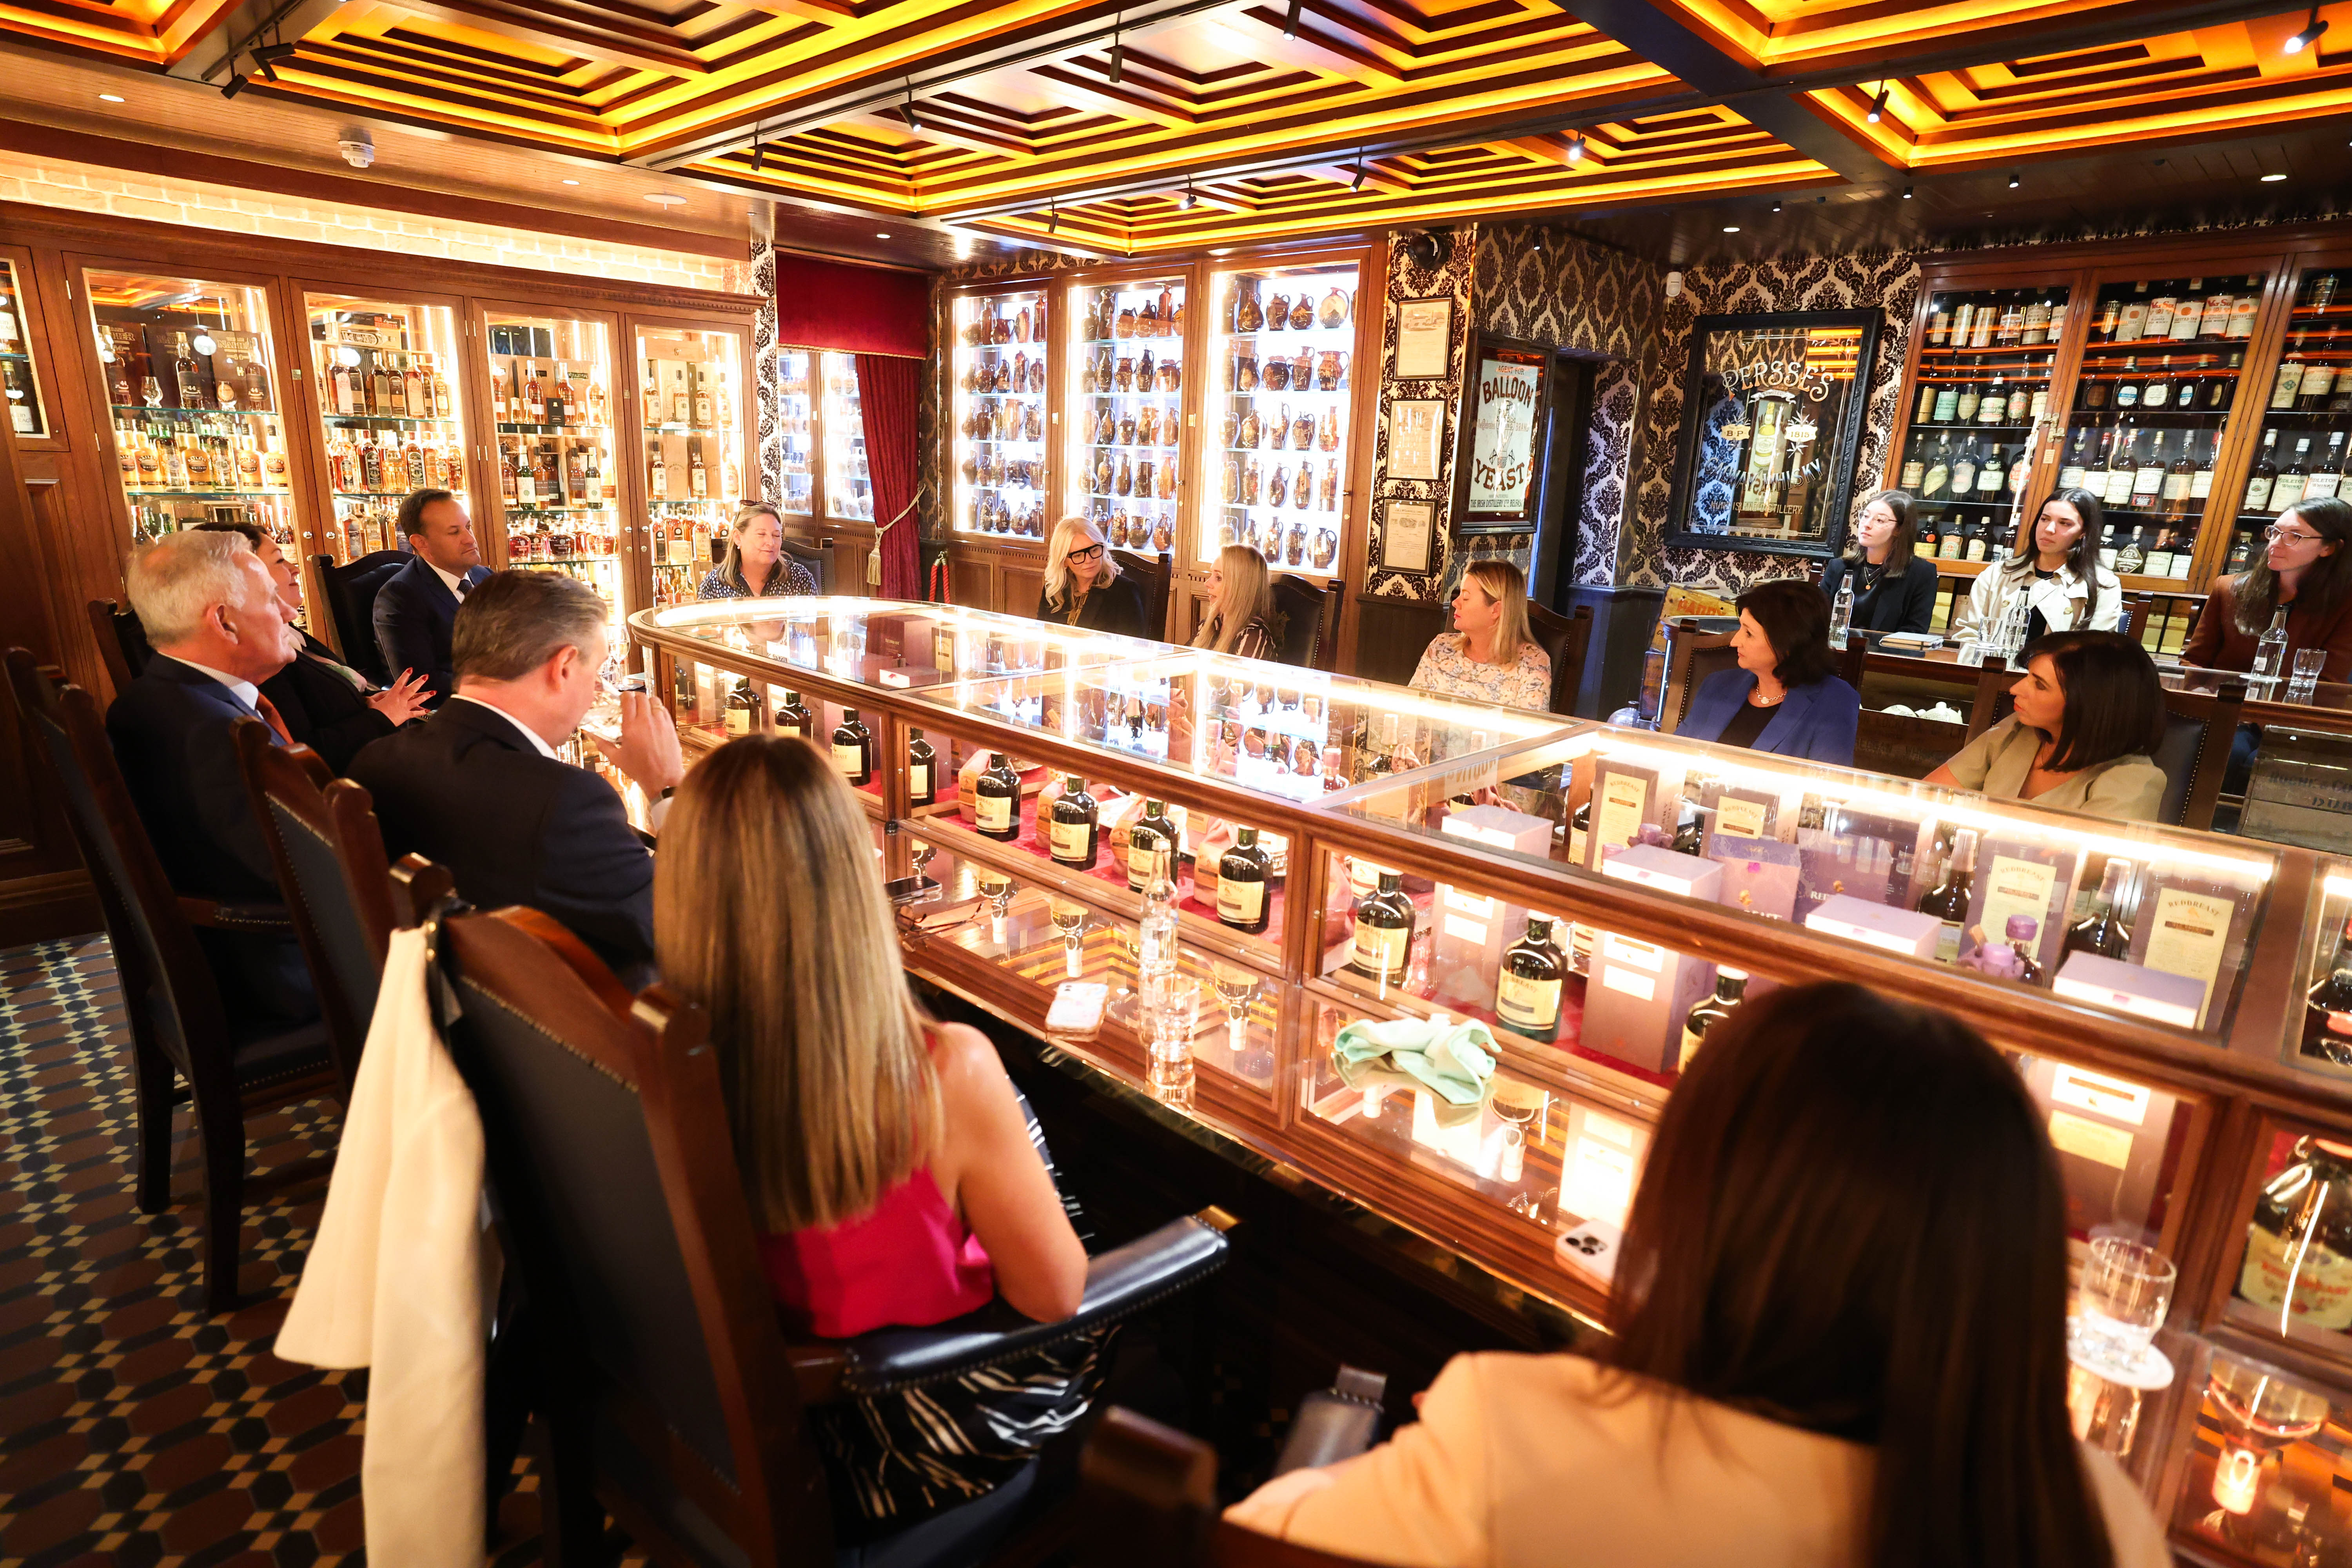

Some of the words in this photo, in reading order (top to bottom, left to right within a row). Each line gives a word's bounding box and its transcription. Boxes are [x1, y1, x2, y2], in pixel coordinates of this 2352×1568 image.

[1498, 365, 1513, 374] AGENT
[1721, 361, 1834, 402] PERSSE'S
[1483, 376, 1534, 408] BALLOON
[1474, 458, 1524, 491] YEAST
[1705, 457, 1758, 492] GALWAY
[1762, 458, 1823, 492] WHISKY
[1725, 806, 1758, 818] REDBREAST
[2001, 867, 2044, 881] REDBREAST
[2168, 900, 2220, 916] REDBREAST
